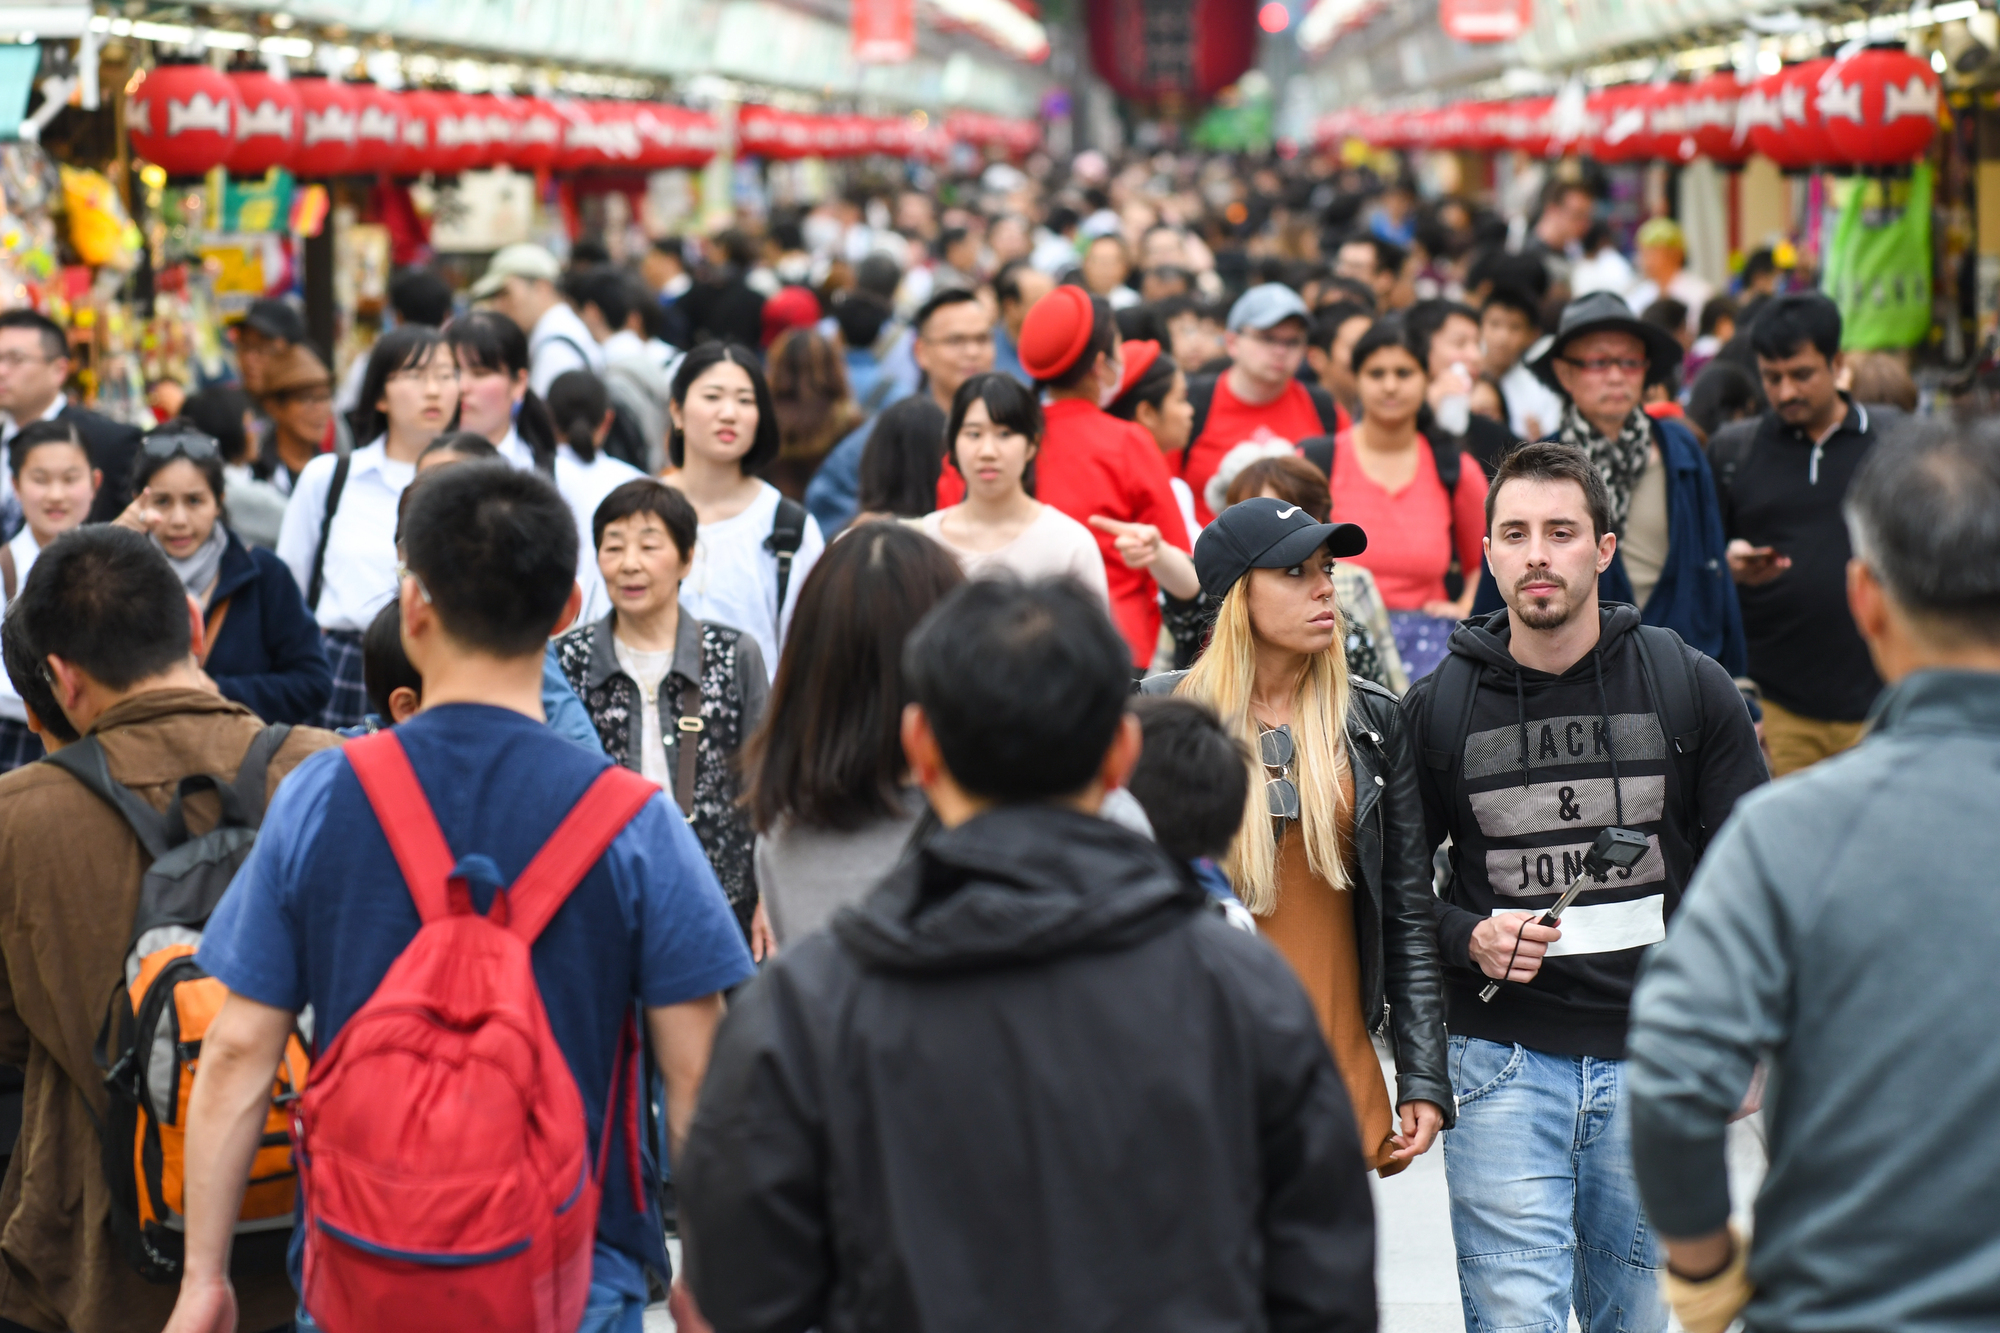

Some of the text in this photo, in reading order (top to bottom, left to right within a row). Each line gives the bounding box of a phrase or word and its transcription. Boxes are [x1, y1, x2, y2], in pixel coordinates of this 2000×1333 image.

[1518, 721, 1612, 763] ACK
[1559, 786, 1581, 821] &
[1519, 849, 1632, 889] JON
